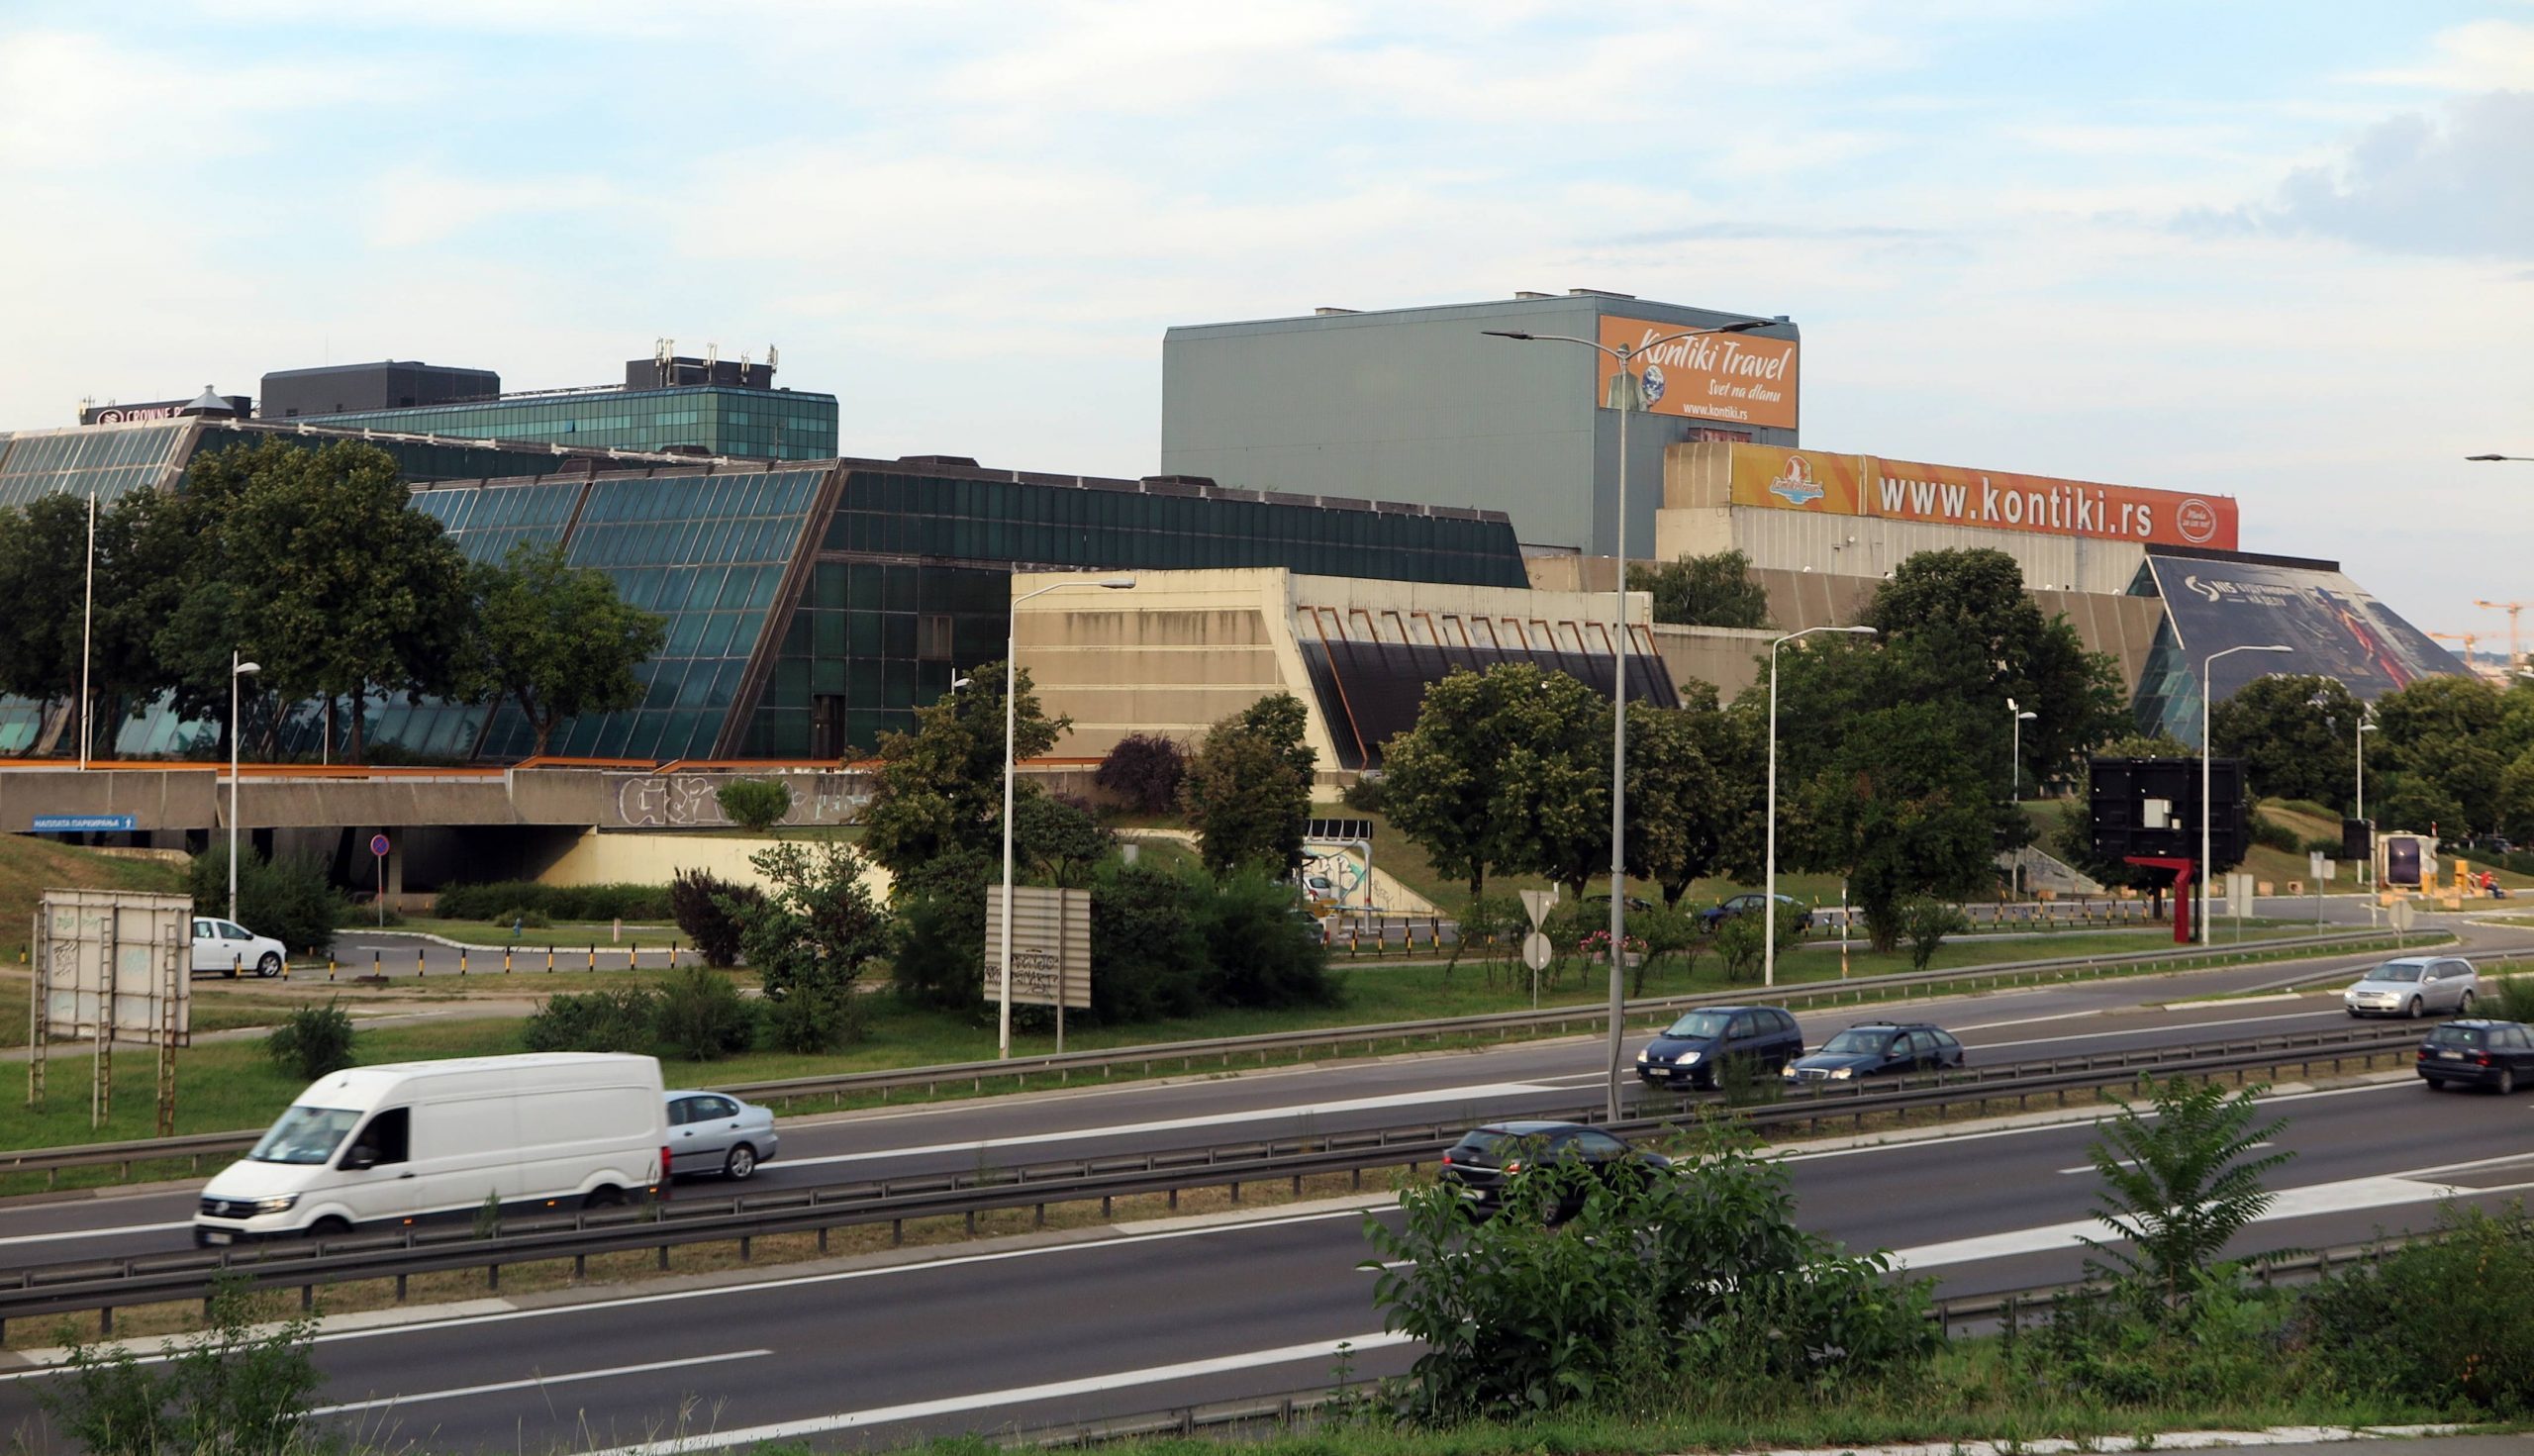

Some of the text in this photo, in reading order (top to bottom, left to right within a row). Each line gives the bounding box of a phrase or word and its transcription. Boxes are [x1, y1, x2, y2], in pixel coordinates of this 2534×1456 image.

[1722, 340, 1792, 381] Travel
[1707, 379, 1781, 403] Svet na dlanu
[126, 407, 171, 422] CROWNE
[1683, 402, 1748, 421] www.kontiki.rs
[1880, 476, 2153, 537] www.kontiki.rs
